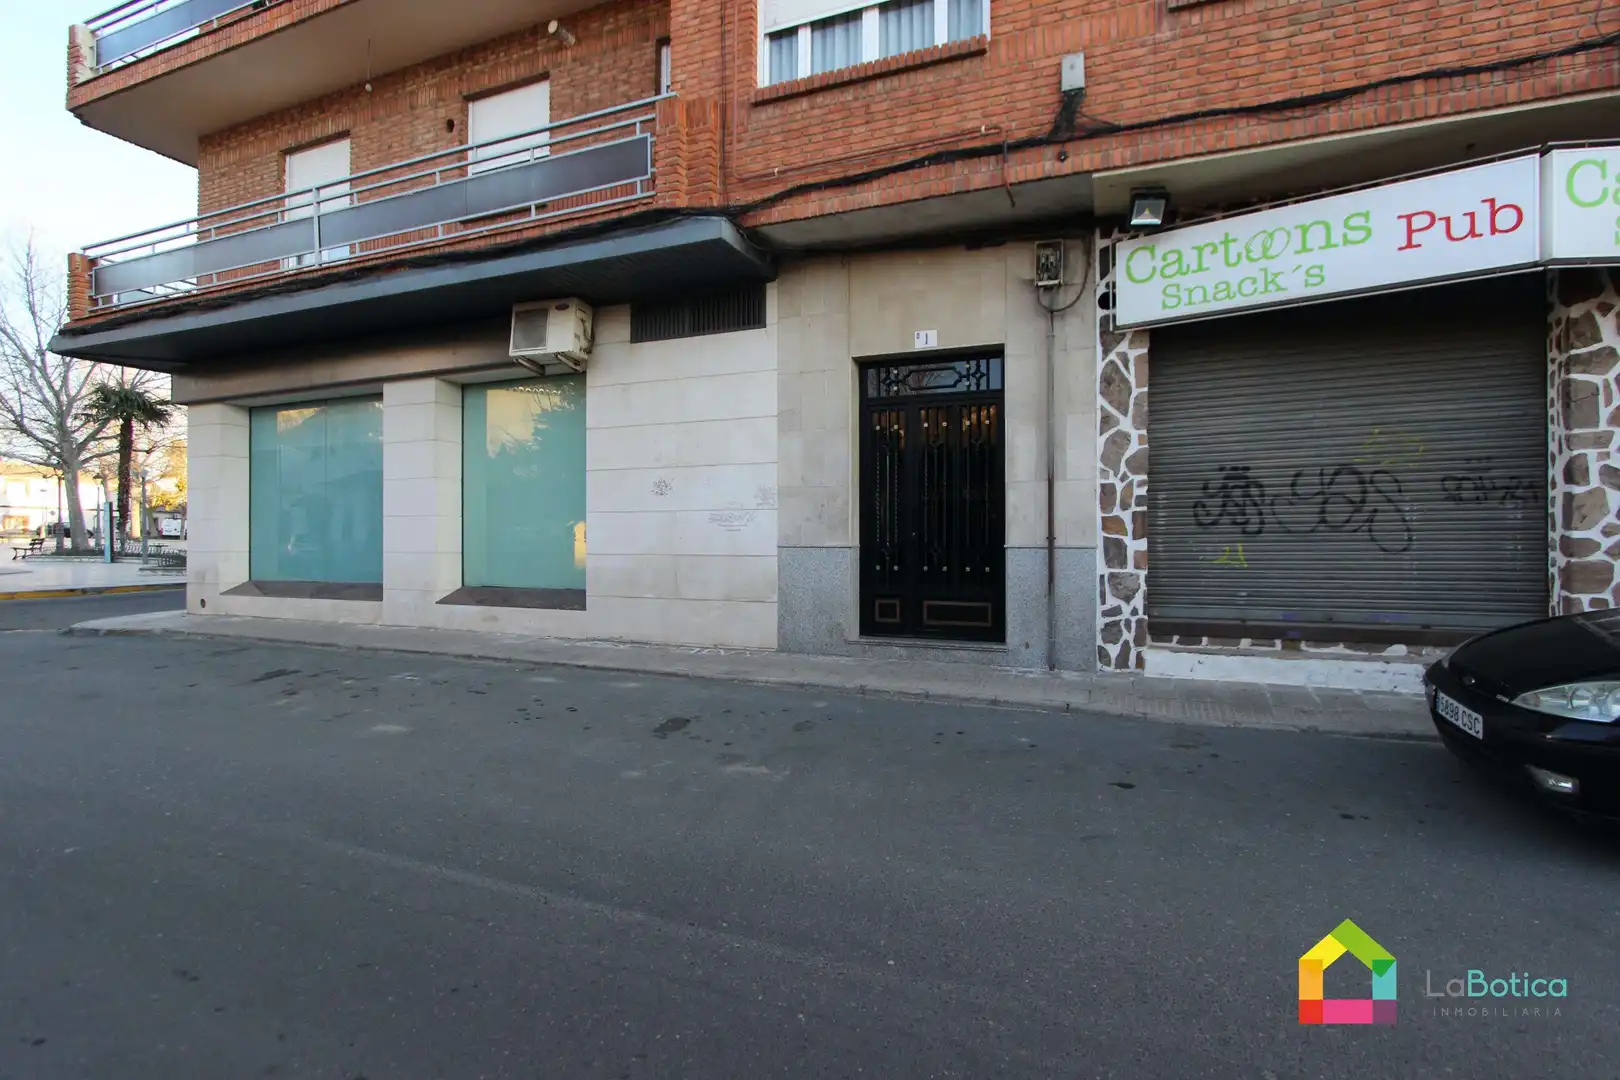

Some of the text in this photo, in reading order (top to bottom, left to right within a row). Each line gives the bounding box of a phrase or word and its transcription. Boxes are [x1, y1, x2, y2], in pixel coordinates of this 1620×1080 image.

[1566, 158, 1620, 208] C
[1125, 197, 1525, 285] Cartoons Pub
[1461, 710, 1481, 734] CSC
